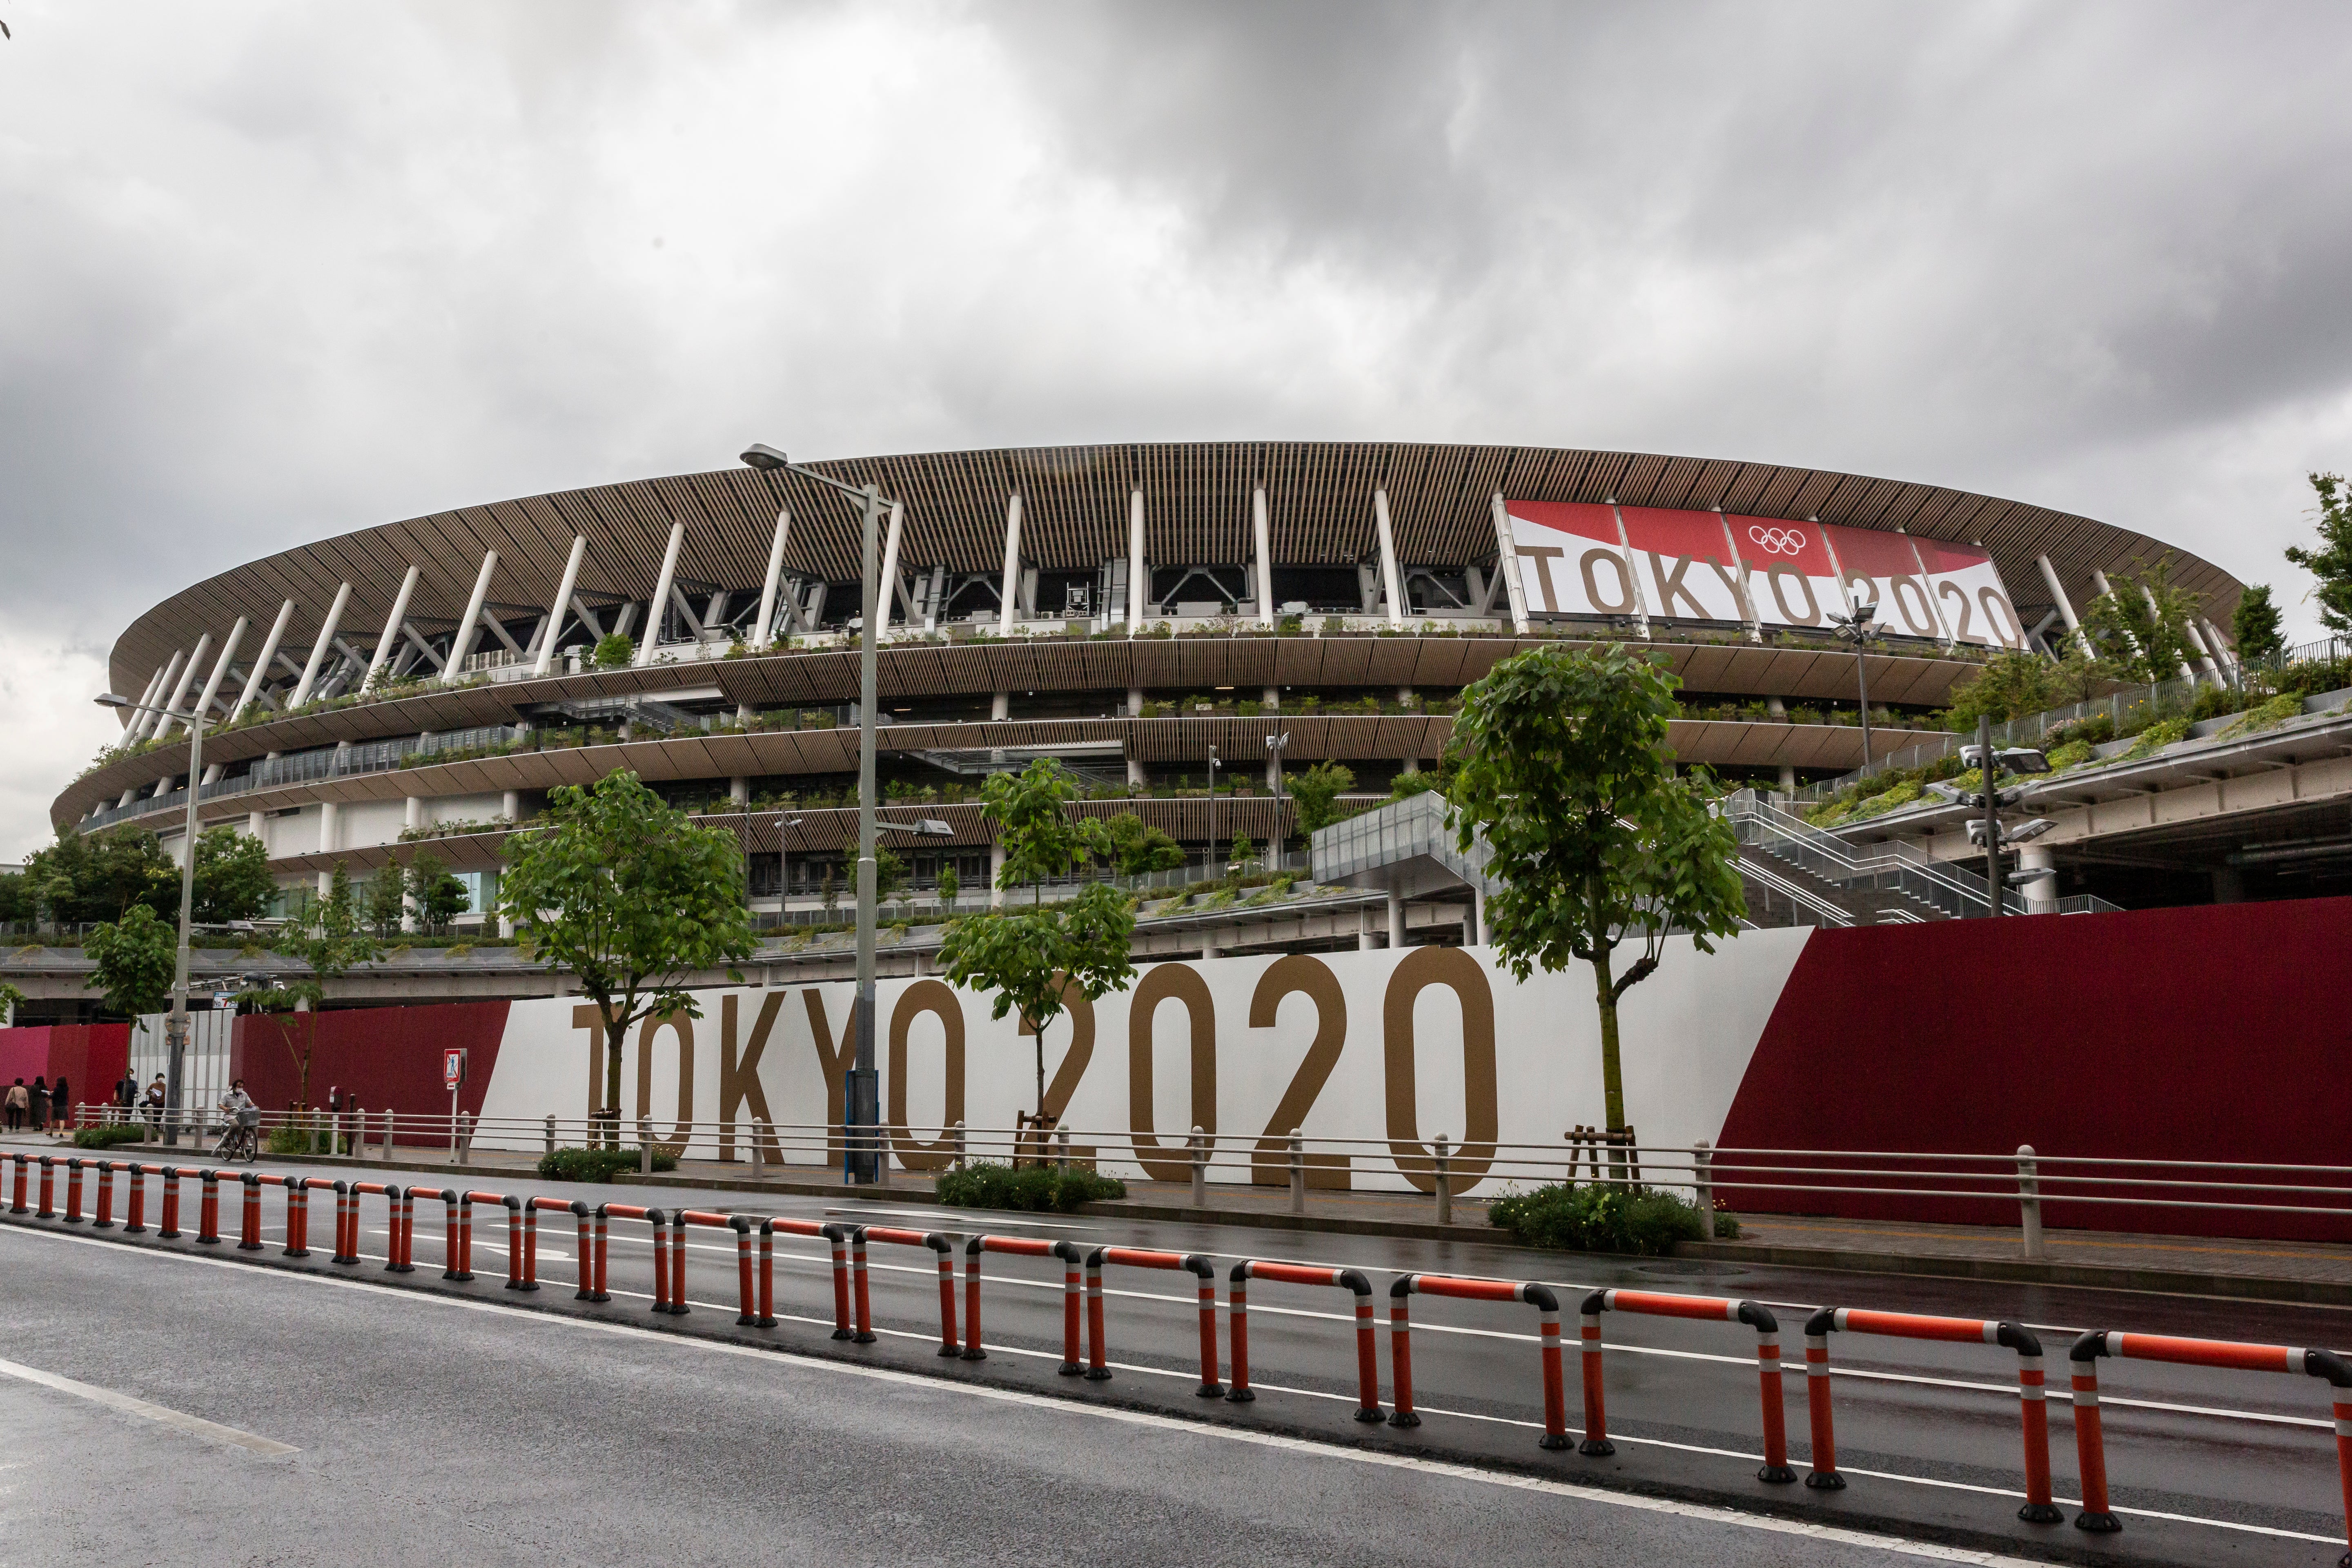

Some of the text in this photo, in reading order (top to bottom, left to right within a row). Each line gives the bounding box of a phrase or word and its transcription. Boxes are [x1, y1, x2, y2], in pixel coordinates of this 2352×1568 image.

[1515, 545, 2024, 649] TOKYO 2020
[222, 998, 228, 1007] 7
[572, 945, 1498, 1195] TOKYO 2020
